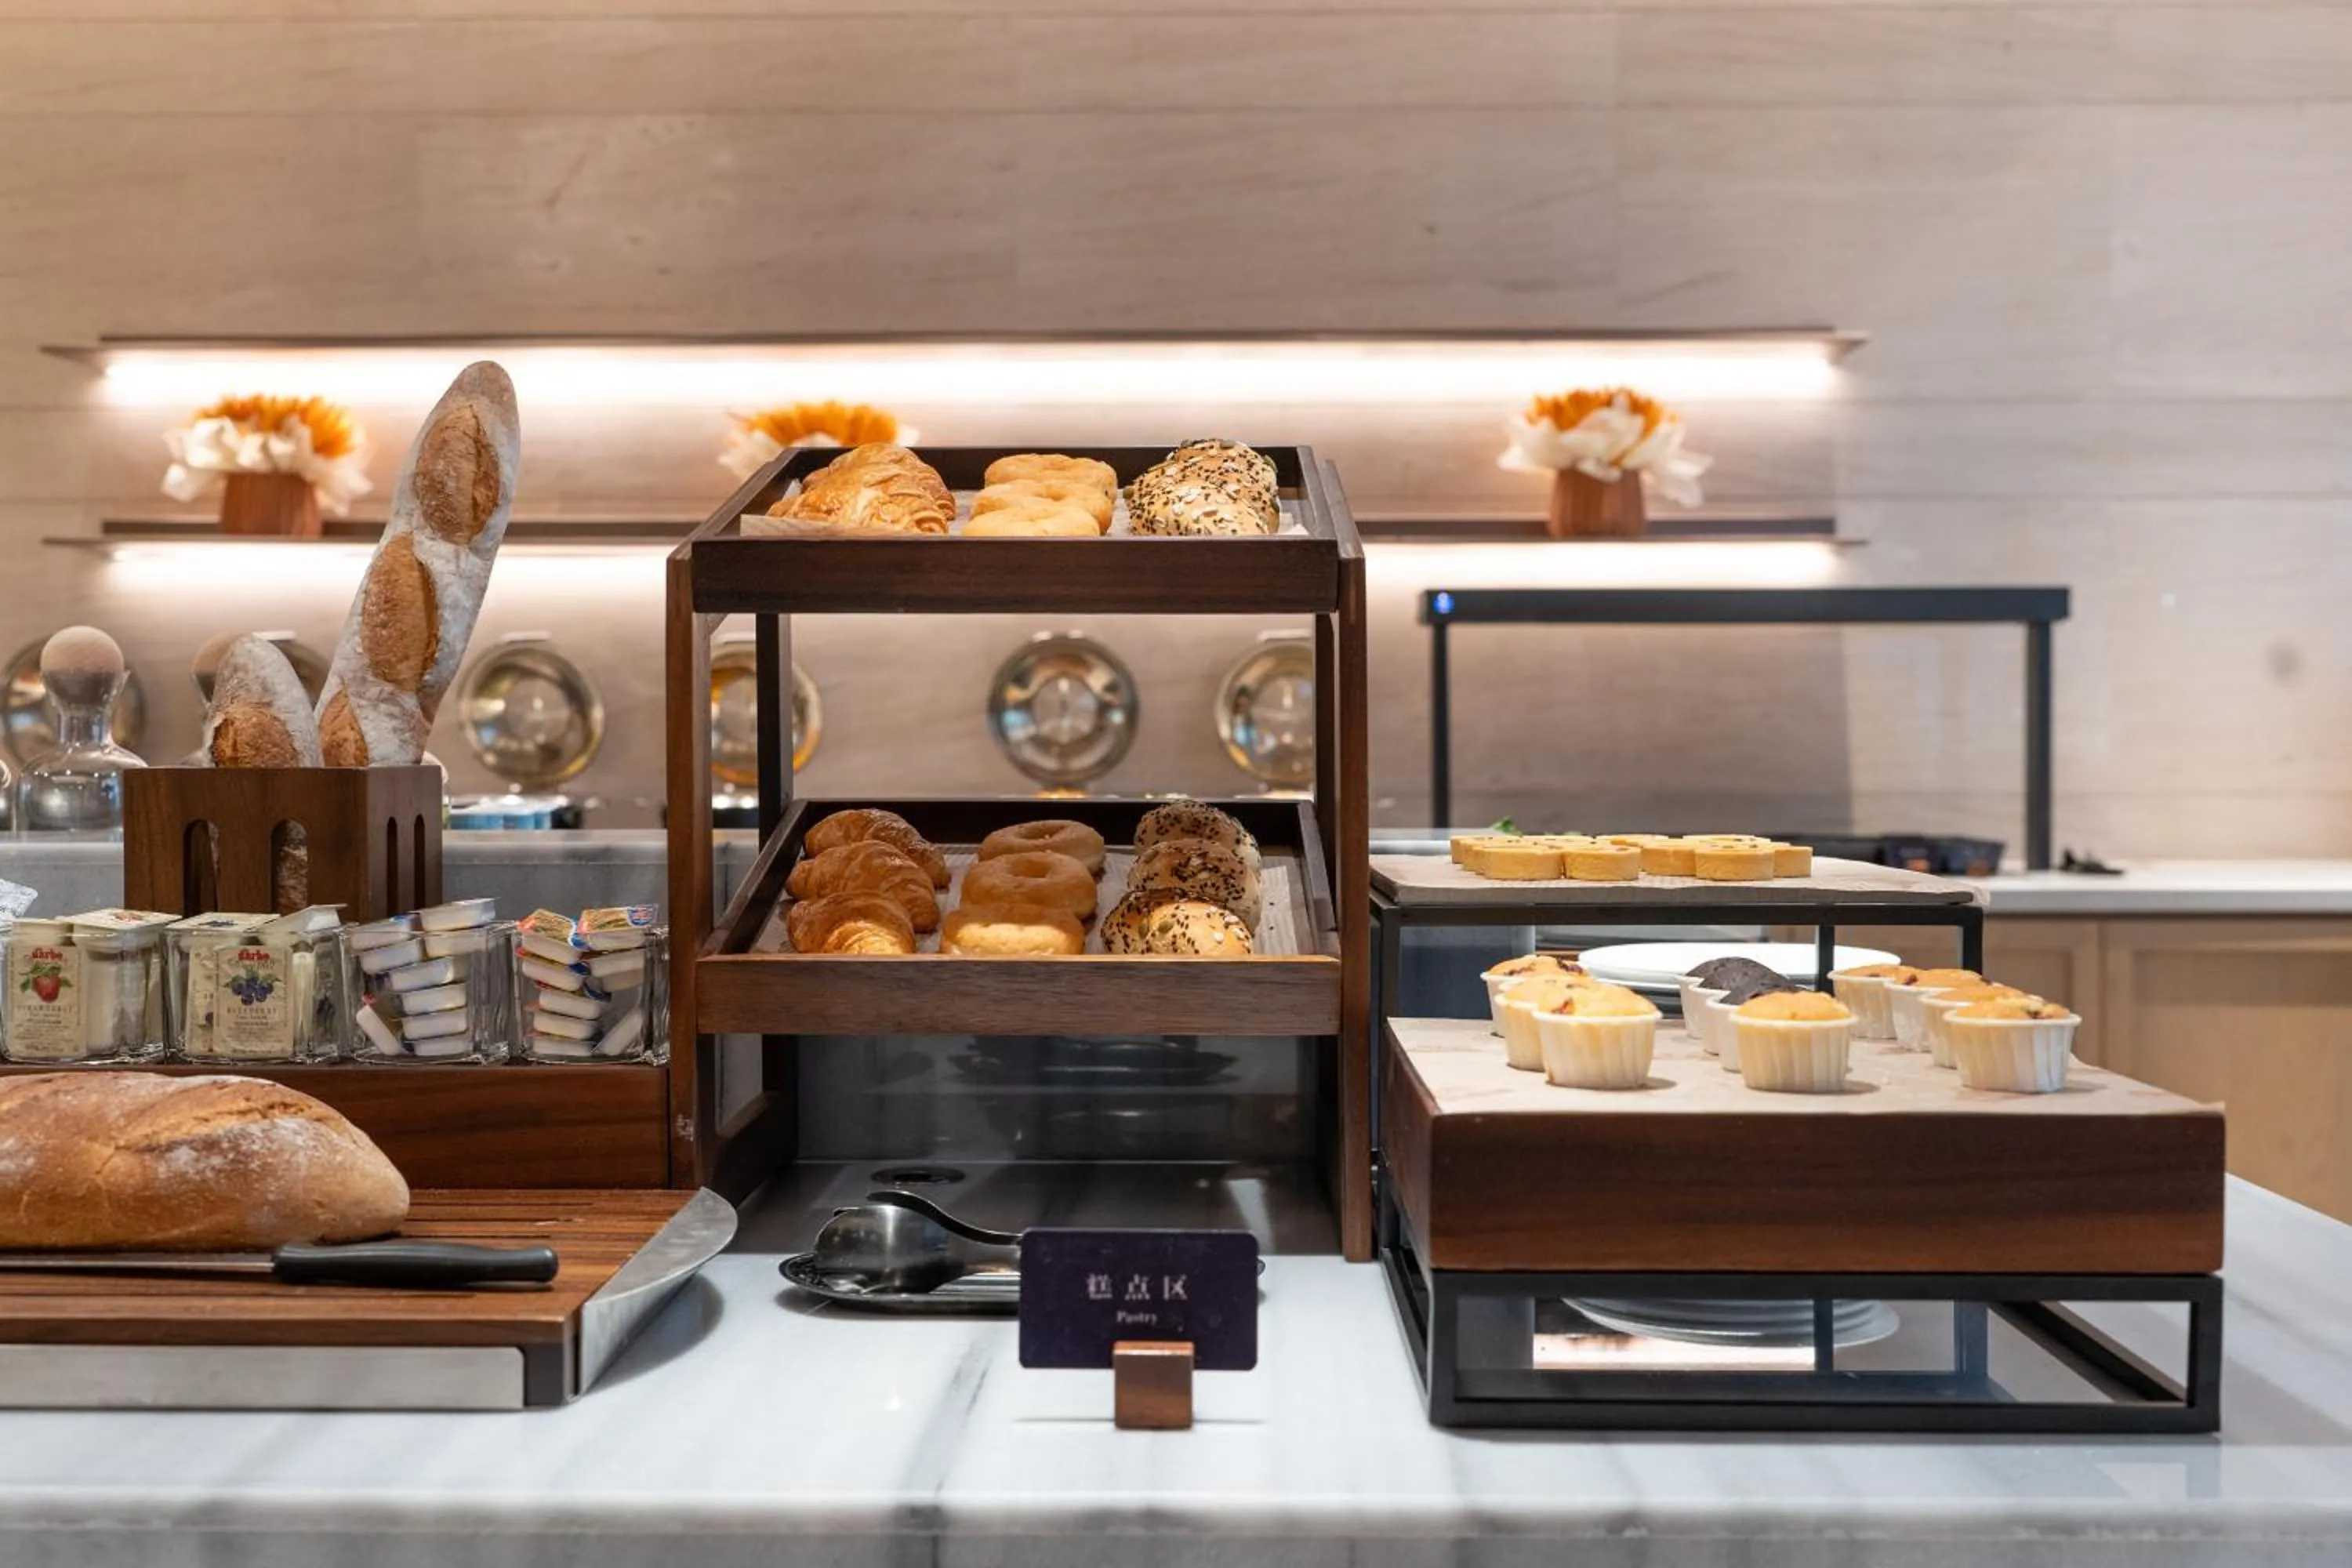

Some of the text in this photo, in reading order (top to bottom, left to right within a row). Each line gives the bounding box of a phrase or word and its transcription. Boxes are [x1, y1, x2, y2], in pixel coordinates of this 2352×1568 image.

[1086, 1273, 1188, 1301] 糕点区
[1116, 1310, 1157, 1324] Pastry
